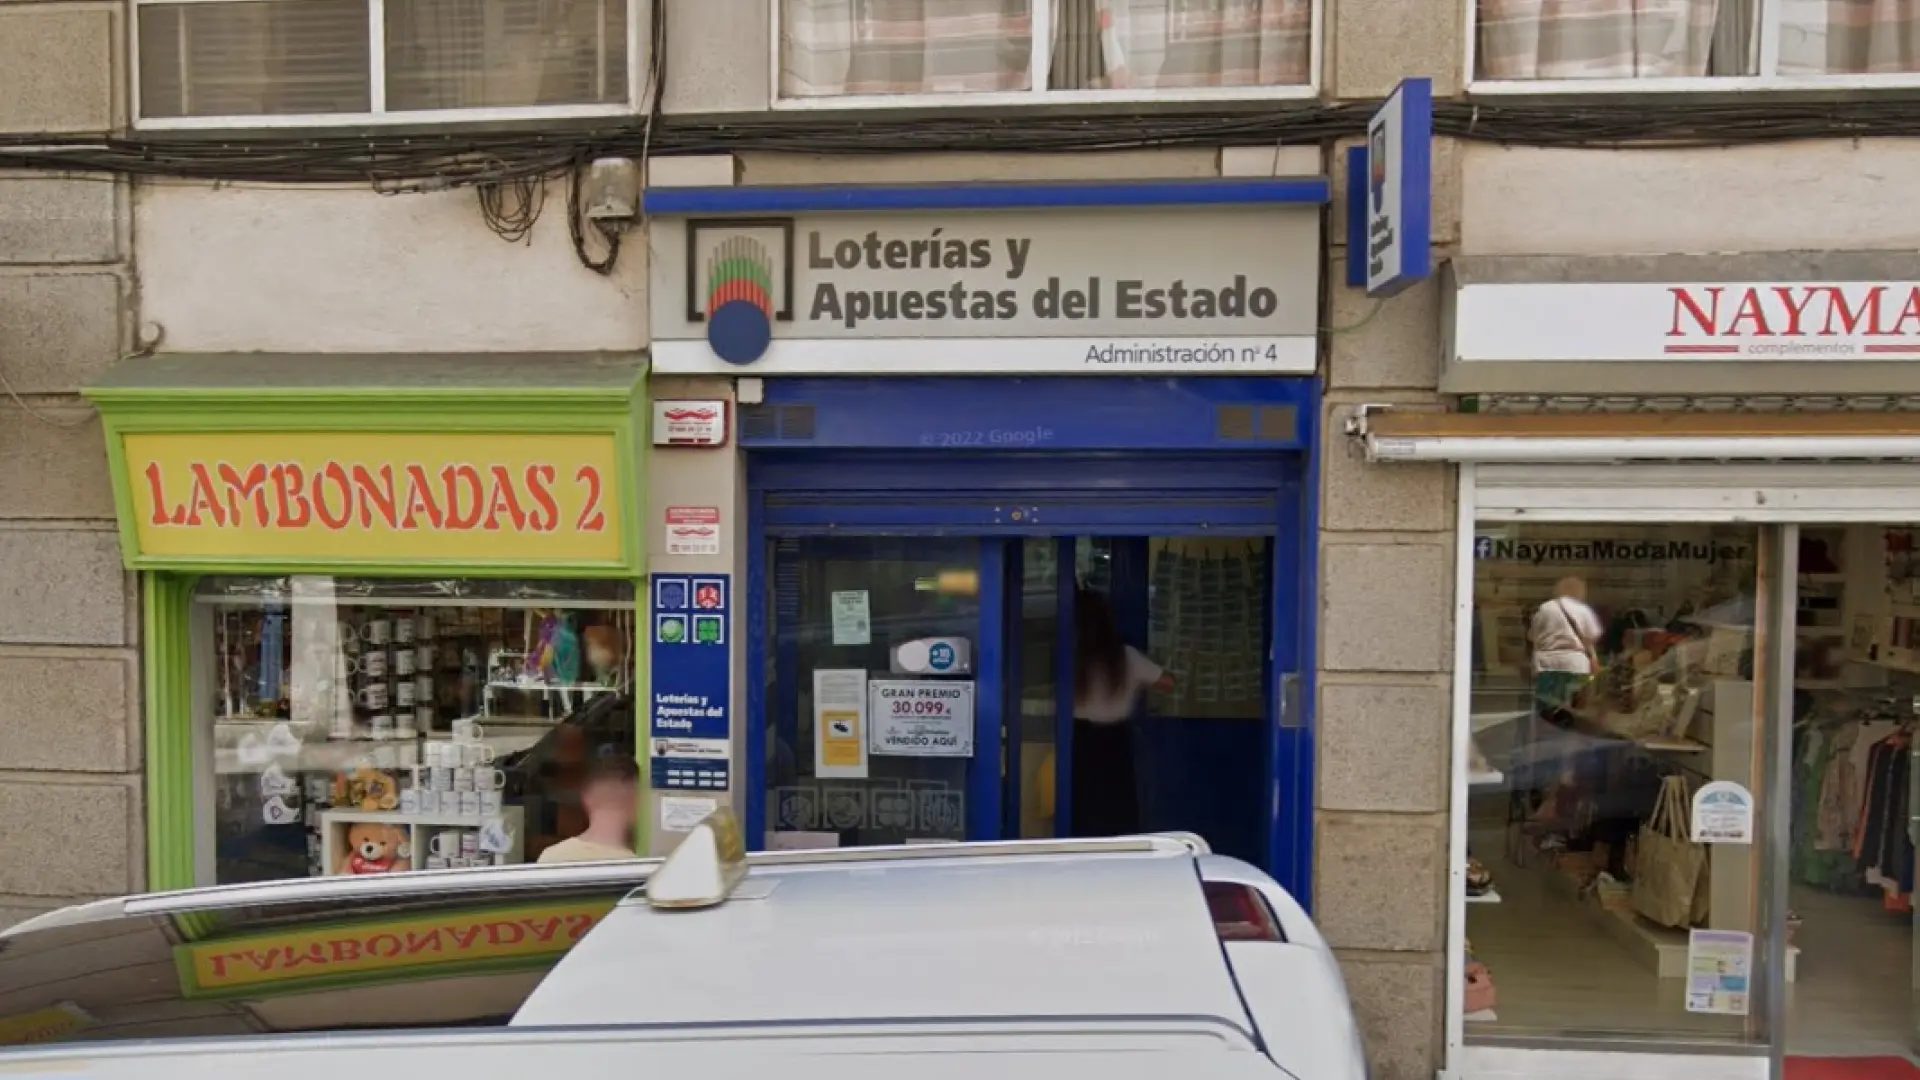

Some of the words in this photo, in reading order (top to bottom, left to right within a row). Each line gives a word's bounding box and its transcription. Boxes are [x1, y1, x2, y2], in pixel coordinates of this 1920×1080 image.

[808, 229, 991, 270] Loterías
[1006, 236, 1031, 276] y
[809, 282, 1018, 328] Apuestas
[1032, 278, 1100, 320] del
[1115, 275, 1278, 319] Estado
[1665, 286, 1920, 337] NAYMA
[1085, 342, 1235, 364] Administración
[1265, 343, 1278, 363] 4
[1747, 341, 1855, 355] complementos
[145, 461, 560, 531] LAMBONADAS
[575, 465, 605, 532] 2
[1496, 539, 1750, 565] NaymaModaMujer
[882, 688, 915, 698] GRAN
[919, 688, 961, 699] PREMIO
[892, 700, 944, 714] 30.099
[885, 735, 929, 746] VENDIDO
